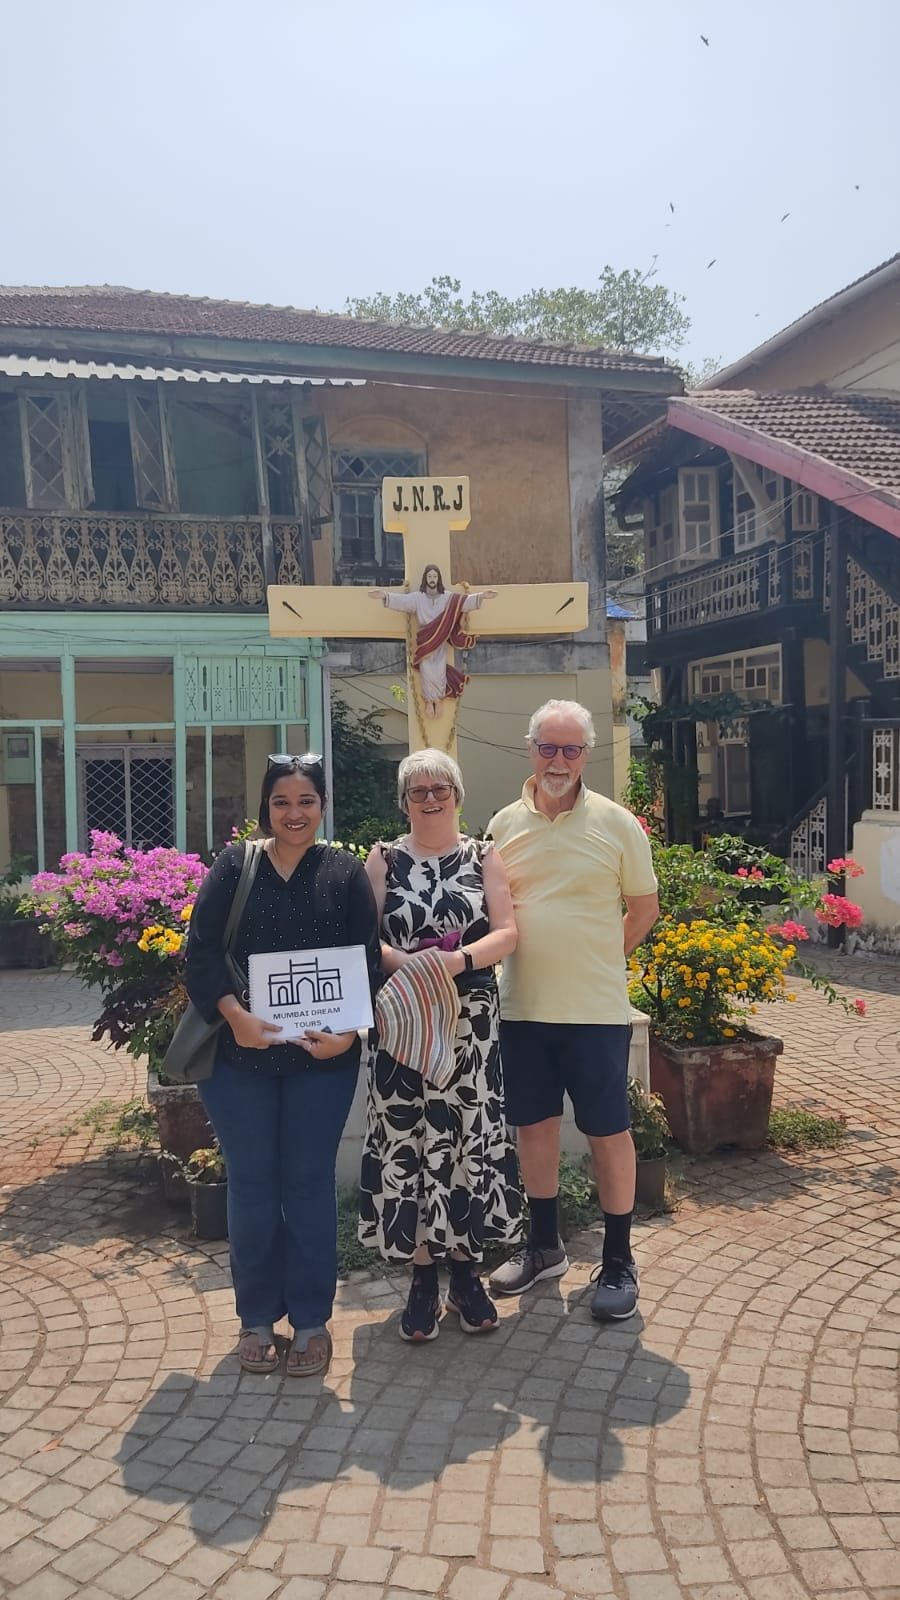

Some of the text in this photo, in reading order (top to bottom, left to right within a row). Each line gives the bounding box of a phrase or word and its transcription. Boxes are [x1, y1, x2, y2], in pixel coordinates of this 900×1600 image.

[273, 1007, 341, 1020] MUMBAI DREAM
[294, 1020, 322, 1029] TOURS
